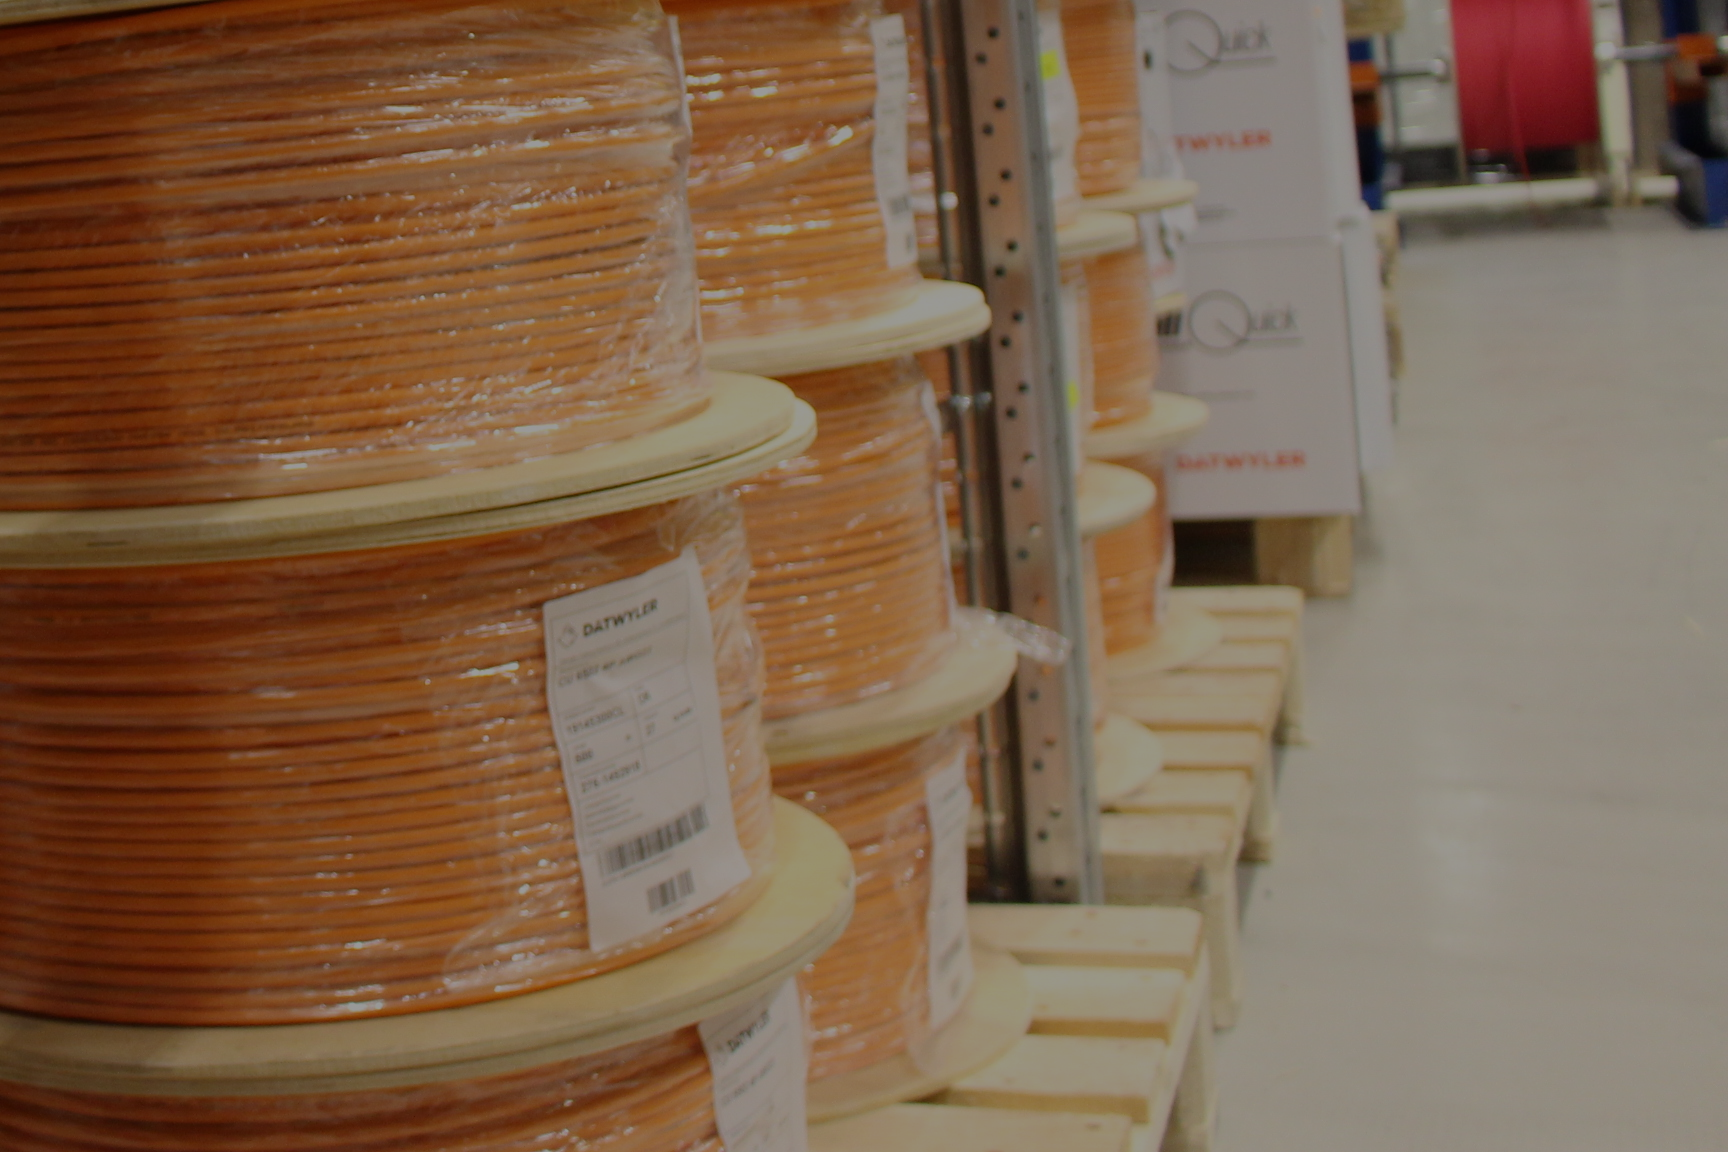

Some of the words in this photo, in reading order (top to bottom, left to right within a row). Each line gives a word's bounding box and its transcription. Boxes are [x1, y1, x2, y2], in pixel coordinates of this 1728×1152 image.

[1173, 128, 1274, 154] TWYLER
[1176, 448, 1307, 473] DATWYLER
[583, 598, 658, 637] DATWYLER
